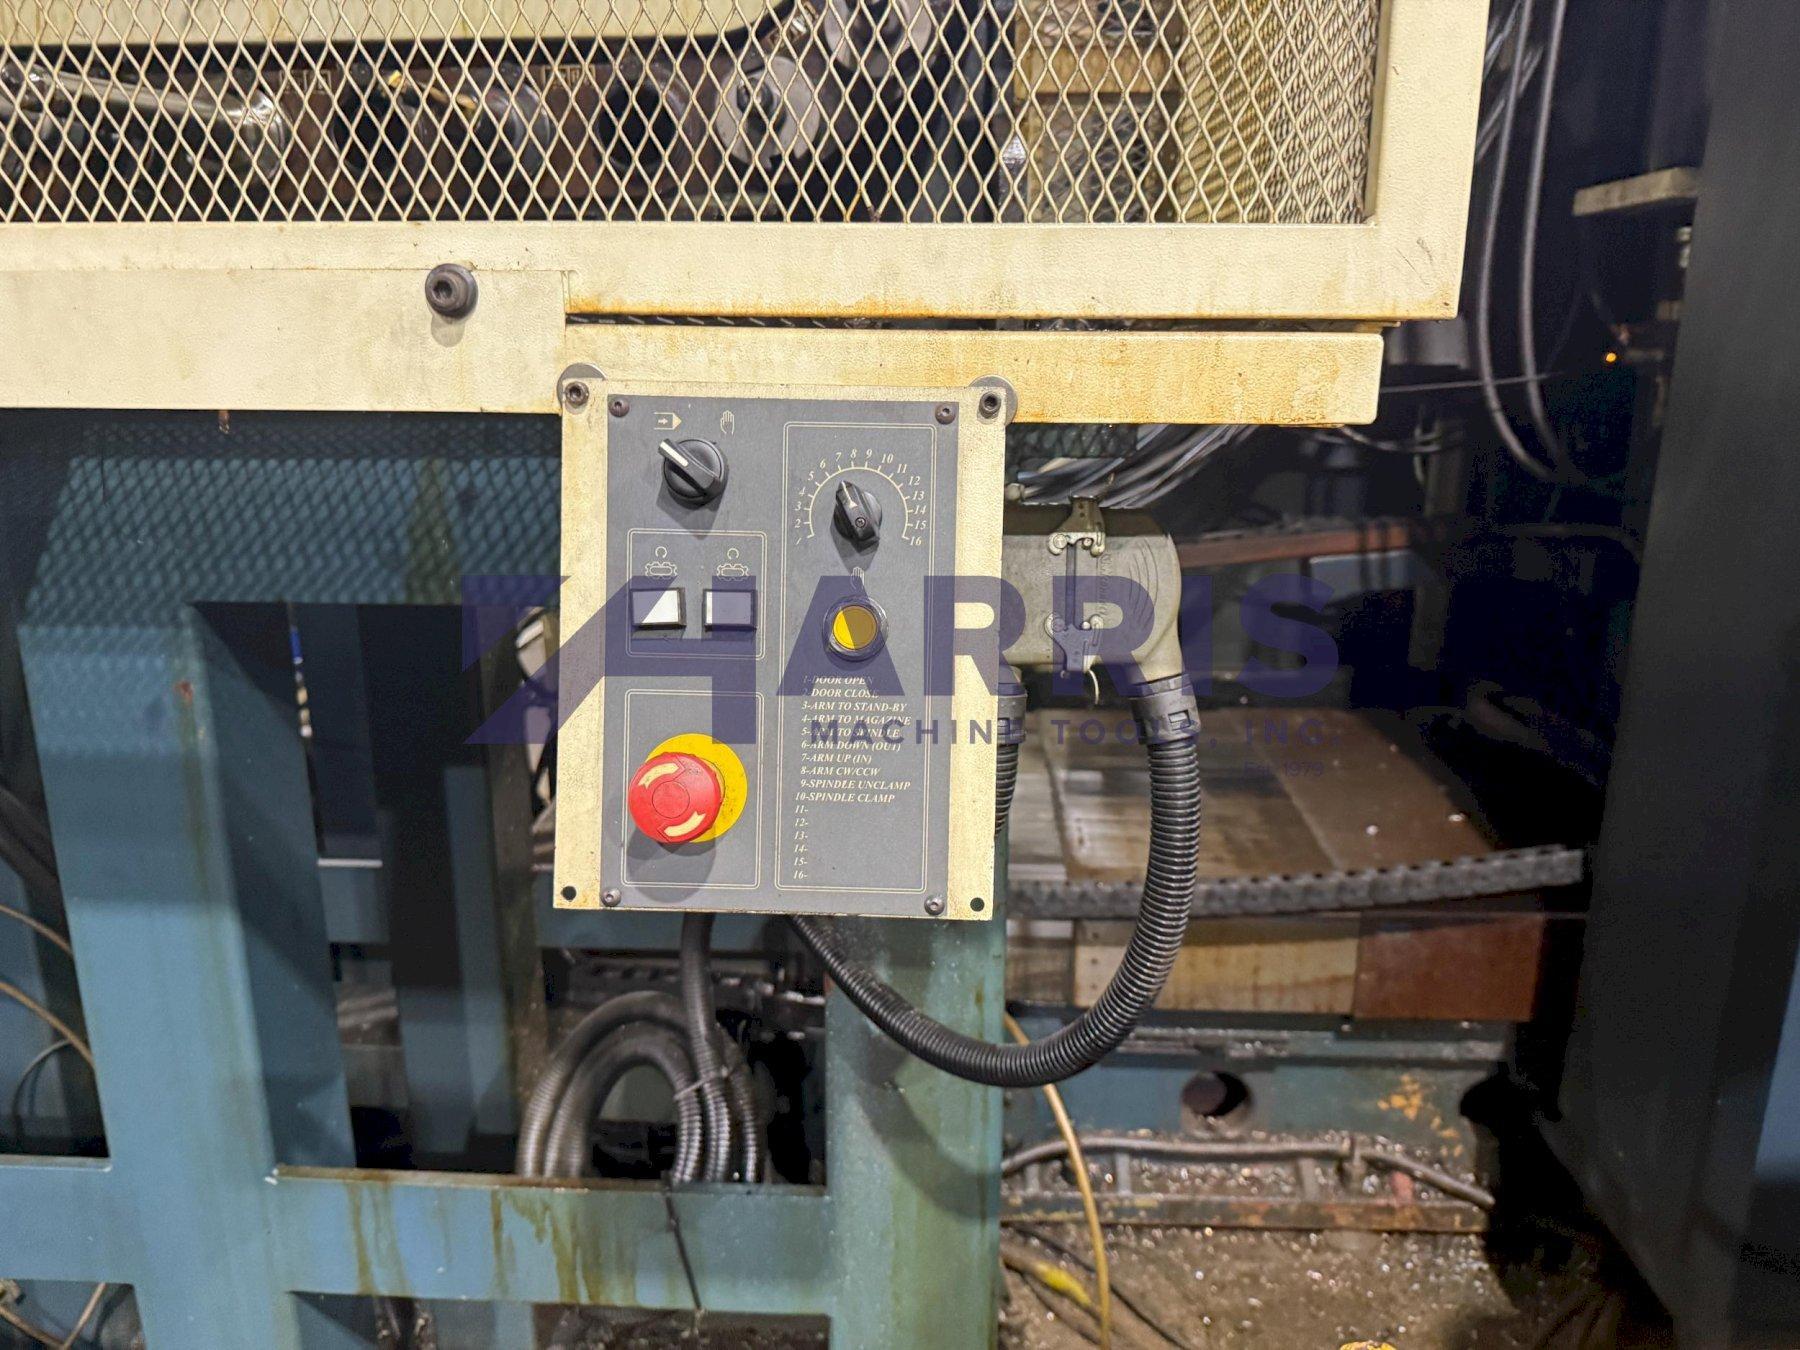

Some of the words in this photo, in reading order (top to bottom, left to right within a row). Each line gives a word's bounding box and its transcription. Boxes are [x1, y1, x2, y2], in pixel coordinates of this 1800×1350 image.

[835, 451, 843, 462] 7
[850, 448, 858, 459] 8
[865, 448, 873, 459] 9
[881, 453, 894, 463] 10
[819, 459, 826, 469] 6
[896, 464, 908, 474] 11
[807, 471, 815, 481] 5
[908, 476, 921, 486] 12
[798, 486, 806, 496] 4
[912, 491, 925, 500] 13
[794, 501, 802, 511] 3
[914, 505, 926, 515] 14
[794, 518, 802, 528] 2
[914, 520, 927, 530] 15
[910, 536, 922, 546] 16
[844, 676, 873, 685] OPEN
[843, 689, 879, 699] CLOSE
[801, 701, 834, 711] 3-ARM
[837, 702, 852, 711] TO
[853, 702, 907, 712] STAND-BY
[801, 714, 834, 724] 4-ARM
[837, 714, 852, 724] TO
[853, 715, 911, 726] MAGAZINE
[800, 727, 834, 737] 5-RM
[837, 727, 851, 737] TO
[801, 740, 834, 749] 6-ARM
[836, 740, 869, 750] DOWN
[872, 741, 901, 752] (OUT)
[801, 753, 834, 762] 7-ARM
[836, 753, 851, 763] UP
[852, 753, 872, 765] (IN)
[800, 766, 834, 775] 8-ARM
[835, 766, 880, 776] CW/CCW
[800, 779, 855, 789] 9-SPINDLE
[857, 780, 911, 790] UNCLAMP
[795, 792, 855, 802] 10-SPINDLE
[857, 793, 895, 803] CLAMP
[795, 805, 809, 814] 11-
[794, 818, 809, 827] 12-
[794, 831, 809, 840] 13-
[793, 844, 808, 853] 14-
[793, 857, 808, 866] 15-
[793, 870, 808, 879] 16-
